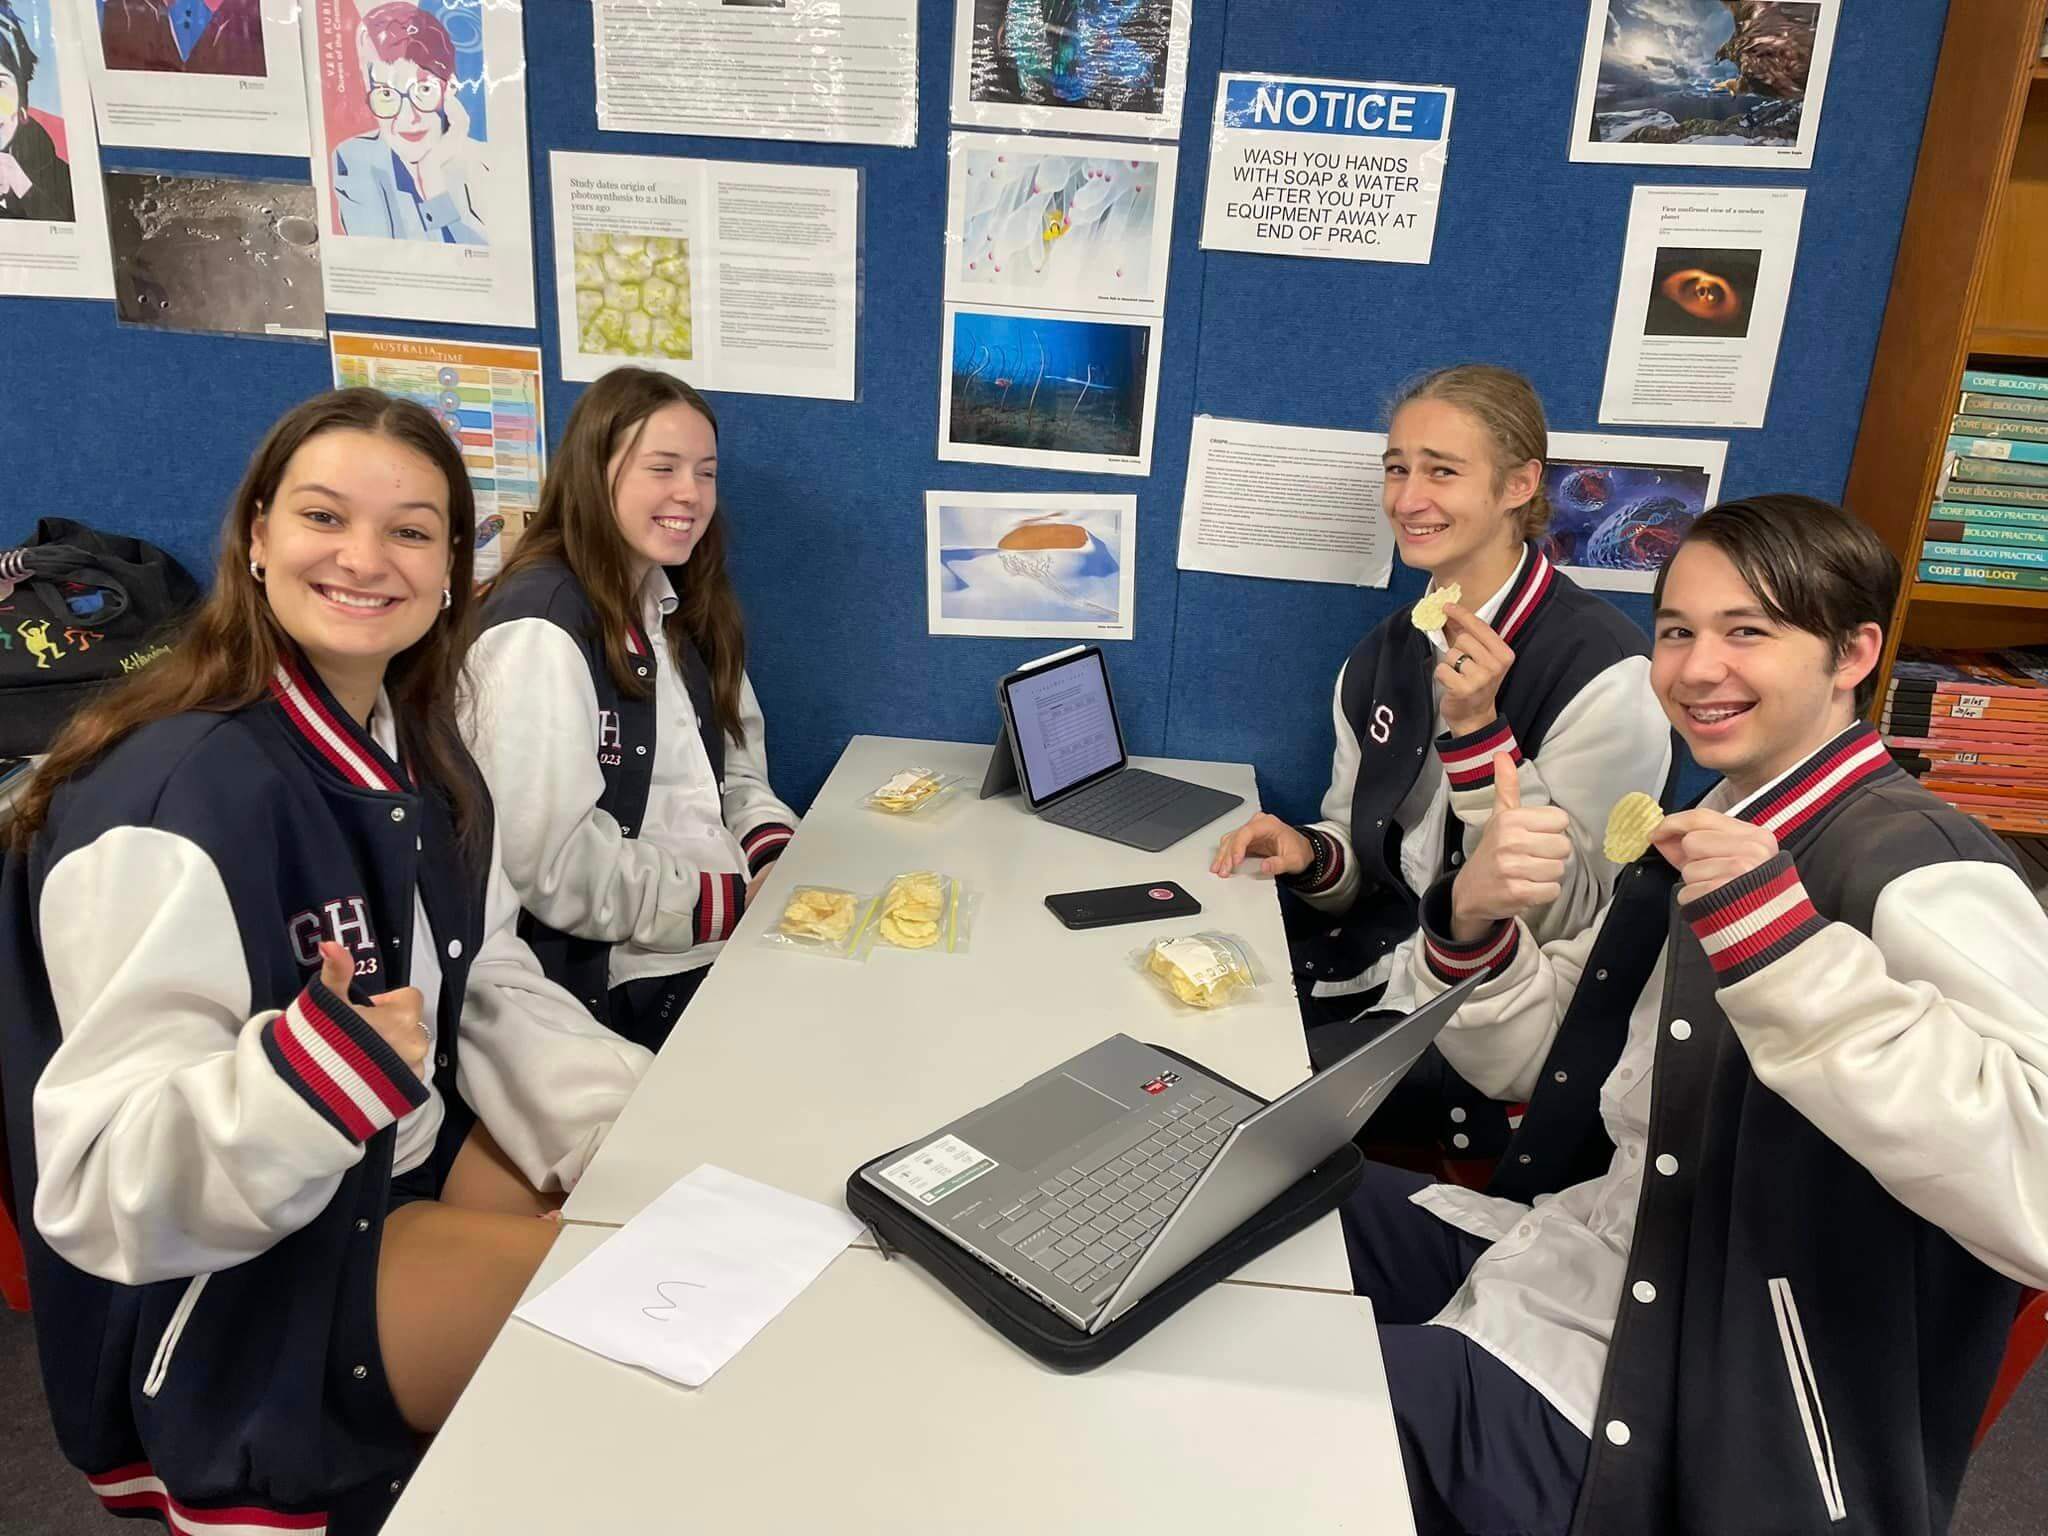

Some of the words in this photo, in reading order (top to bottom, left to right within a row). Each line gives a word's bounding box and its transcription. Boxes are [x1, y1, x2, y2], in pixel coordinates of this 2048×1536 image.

[325, 42, 335, 77] VERA
[1254, 87, 1416, 132] NOTICE
[1244, 148, 1297, 166] WASH
[1303, 152, 1341, 169] YOU
[1346, 155, 1408, 173] HANDS
[570, 178, 594, 190] Study
[596, 180, 619, 190] dates
[620, 182, 645, 192] origin
[647, 183, 657, 192] of
[1233, 166, 1279, 183] WITH
[1284, 170, 1333, 187] SOAP
[1338, 173, 1349, 188] &
[1355, 174, 1419, 192] WATER
[571, 190, 633, 202] photosynthesis
[635, 195, 645, 203] to
[646, 196, 658, 204] 2.1
[660, 194, 687, 206] billion
[1252, 186, 1311, 204] AFTER
[1317, 190, 1354, 207] YOU
[1359, 193, 1395, 209] PUT
[571, 202, 593, 212] years
[595, 205, 610, 213] ago
[1227, 203, 1332, 224] EQUIPMENT
[1336, 210, 1390, 227] AWAY
[1393, 213, 1417, 229] AT
[1256, 223, 1294, 239] END
[1299, 226, 1324, 241] OF
[1328, 227, 1381, 245] PRAC.
[372, 342, 436, 354] AUSTRALIA
[438, 353, 464, 361] TIME
[1973, 377, 1998, 387] CORE
[1998, 380, 2037, 390] BIOLOGY
[1992, 402, 2032, 413] BIOLOGY
[1956, 420, 1980, 429] CORE
[1981, 422, 2020, 432] BIOLOGY
[1948, 487, 1972, 495] CORE
[1974, 487, 2012, 498] BIOLOGY
[1940, 507, 1965, 515] CORE
[1965, 508, 2002, 518] BIOLOGY
[1964, 528, 1999, 538] BIOLOGY
[2001, 531, 2046, 542] PRACTICAL
[1934, 546, 1960, 555] CORE
[1960, 547, 1998, 558] BIOLOGY
[2000, 551, 2047, 562] PRACTICAL
[1928, 565, 1961, 576] CORE
[1964, 566, 2018, 580] BIOLOGY
[1371, 705, 1394, 743] S
